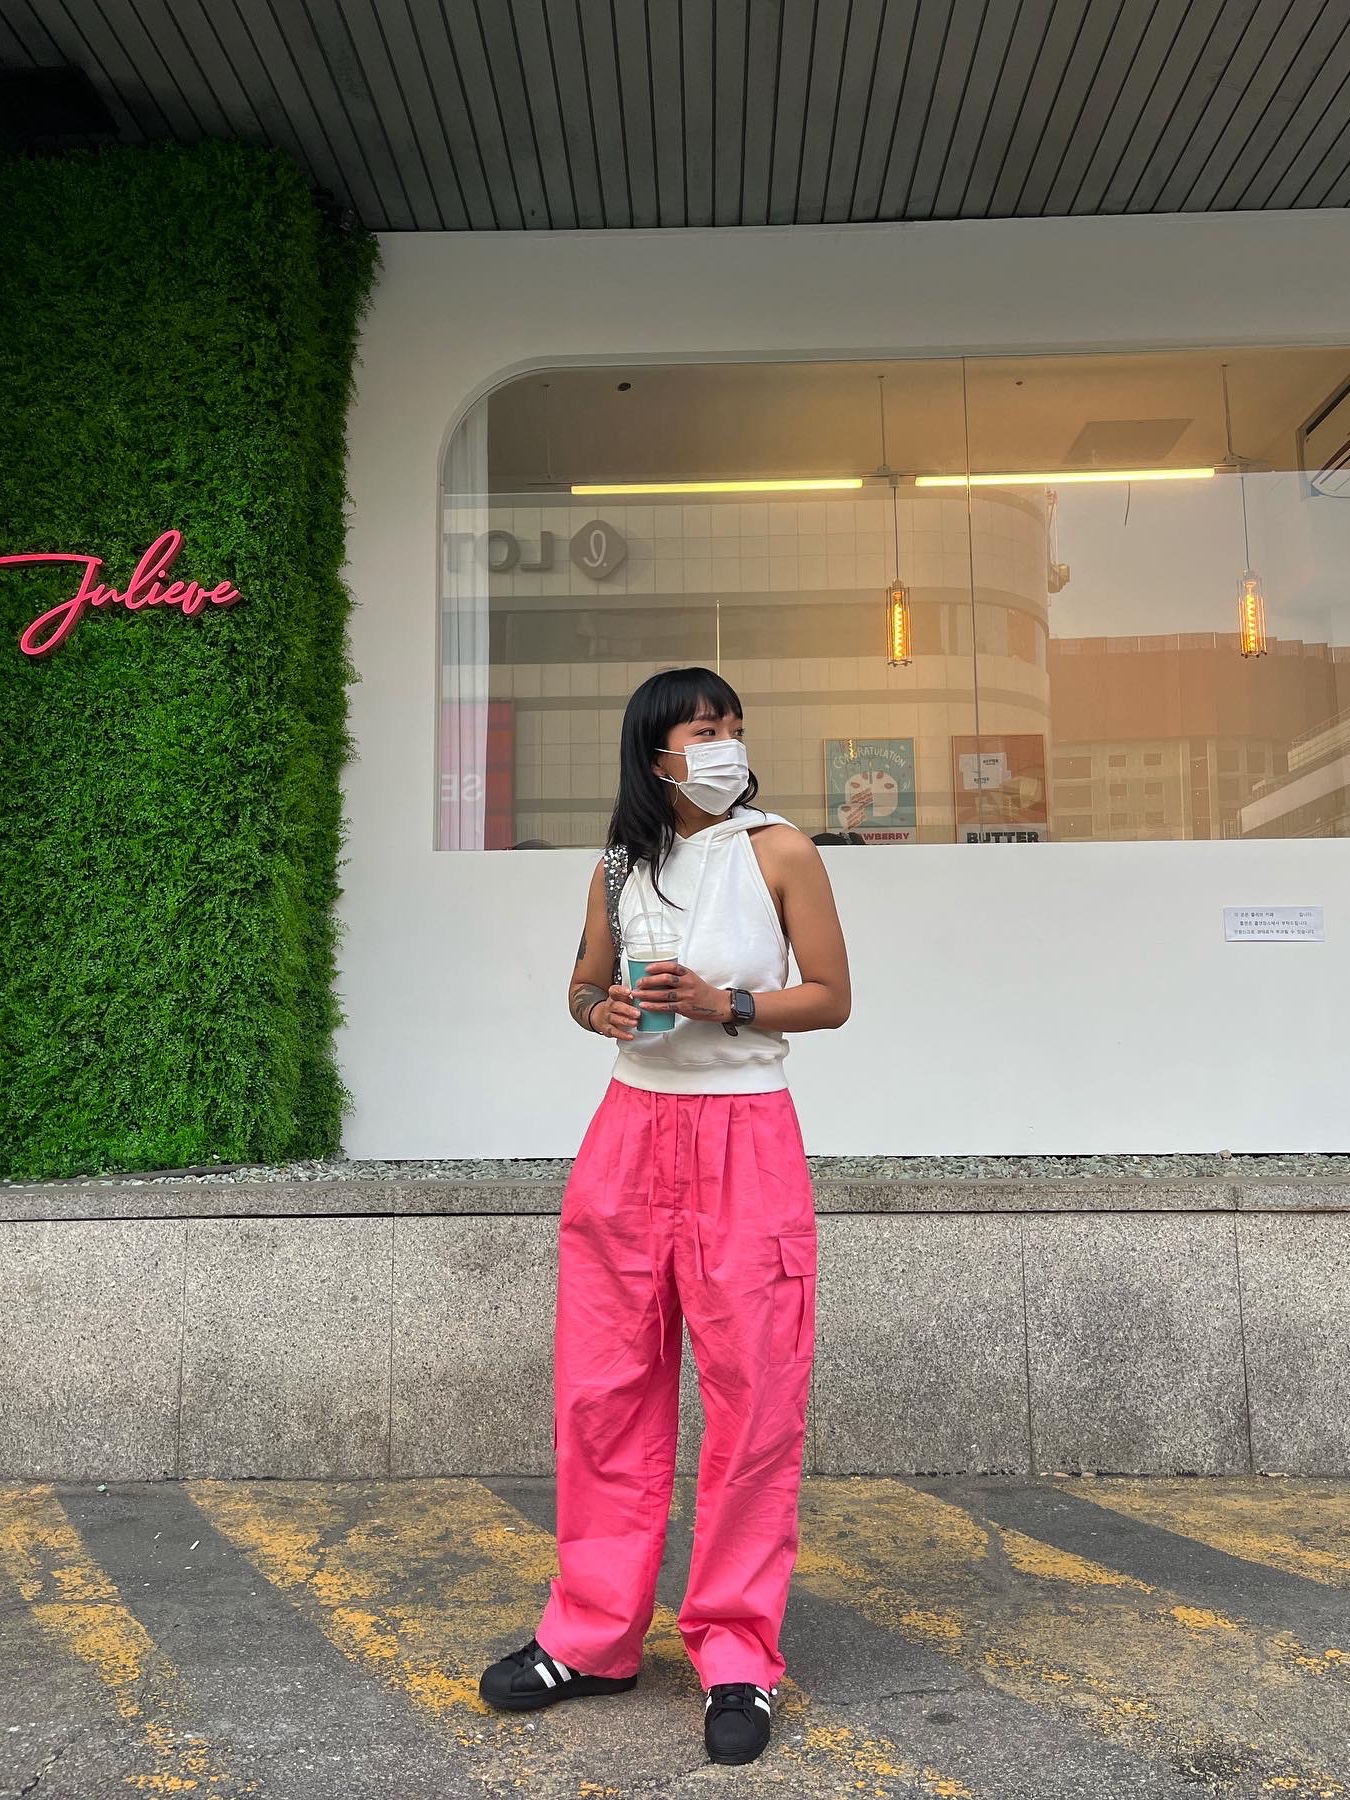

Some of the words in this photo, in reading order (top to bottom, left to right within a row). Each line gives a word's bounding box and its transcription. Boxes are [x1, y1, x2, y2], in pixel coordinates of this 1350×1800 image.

[0, 529, 240, 656] Julieve
[863, 832, 910, 841] WBERRY
[966, 831, 1039, 844] BUTTER
